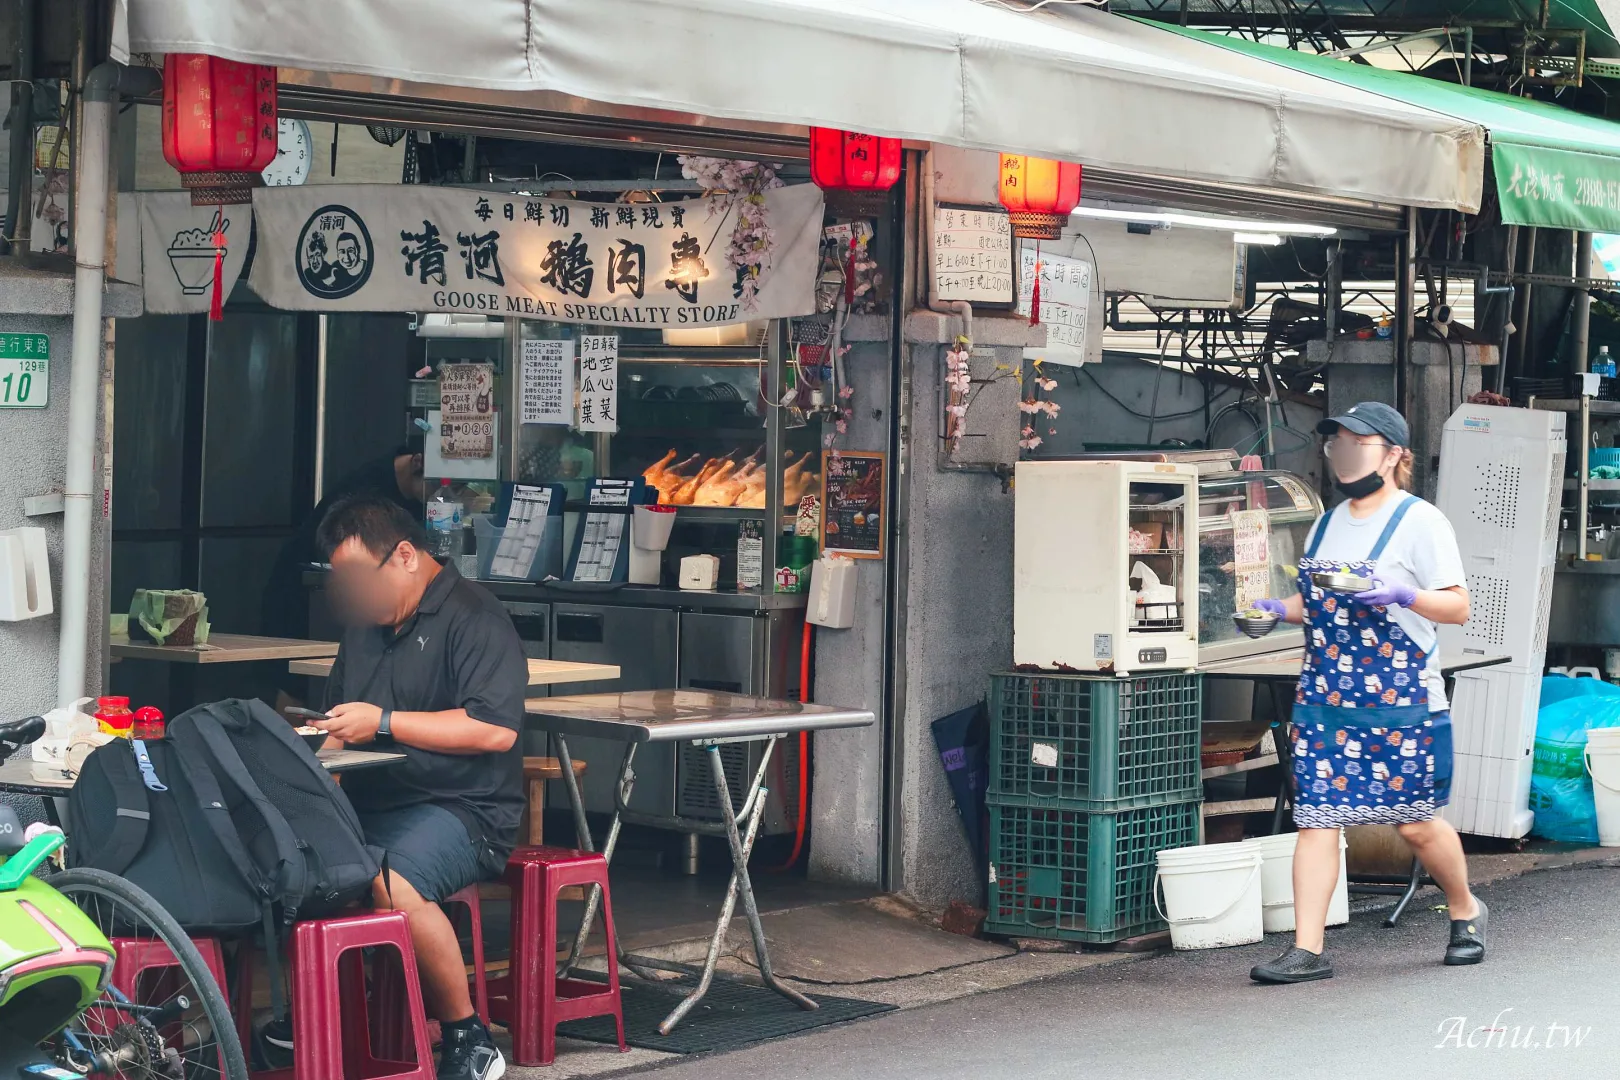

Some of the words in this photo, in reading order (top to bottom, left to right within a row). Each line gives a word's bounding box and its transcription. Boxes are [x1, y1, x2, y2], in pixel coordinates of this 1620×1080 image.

[259, 66, 275, 140] 河鵝肉
[1004, 158, 1020, 187] 鵝肉
[319, 215, 347, 231] 清河
[475, 197, 570, 228] 每日鮮切
[590, 206, 686, 229] 新鮮現賣
[433, 290, 499, 310] GOOSE
[506, 295, 557, 316] MEAT
[565, 303, 671, 323] SPECIALTY
[677, 303, 740, 323] STORE
[3, 372, 32, 402] 10
[581, 357, 598, 424] 地瓜葉
[598, 356, 615, 421] 空心菜
